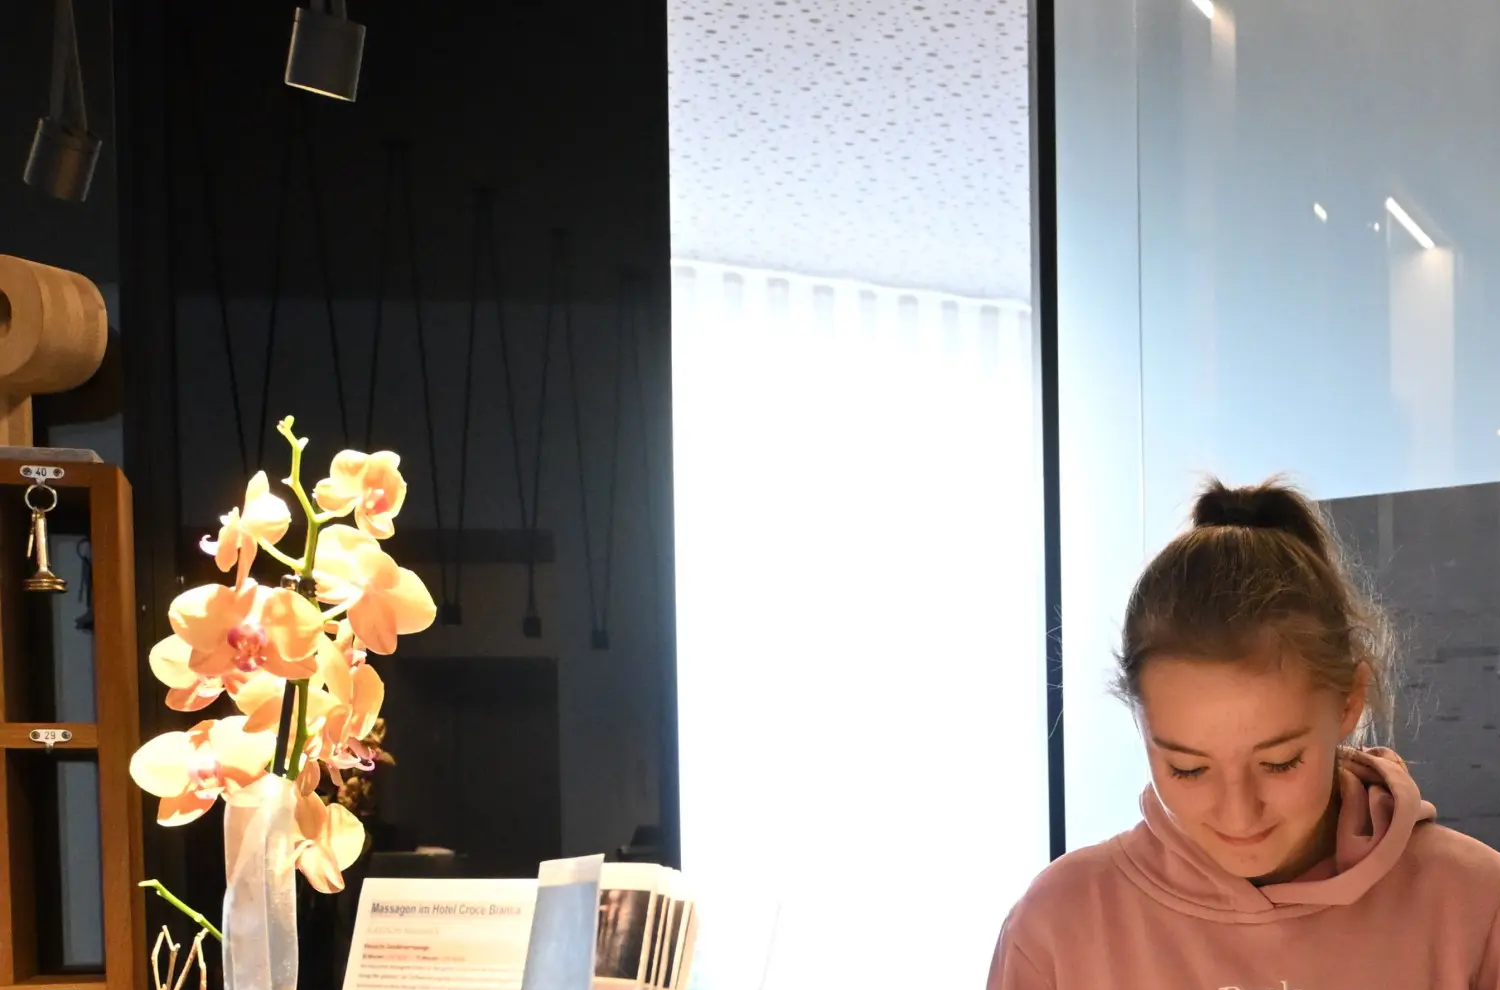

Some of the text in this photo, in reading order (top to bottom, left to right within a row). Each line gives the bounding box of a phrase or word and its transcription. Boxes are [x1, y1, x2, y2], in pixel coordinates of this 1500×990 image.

[35, 468, 47, 477] 40
[44, 731, 56, 740] 29
[371, 902, 417, 917] Massagen
[418, 904, 430, 915] im
[432, 904, 456, 915] Hotel
[458, 903, 485, 916] Croce
